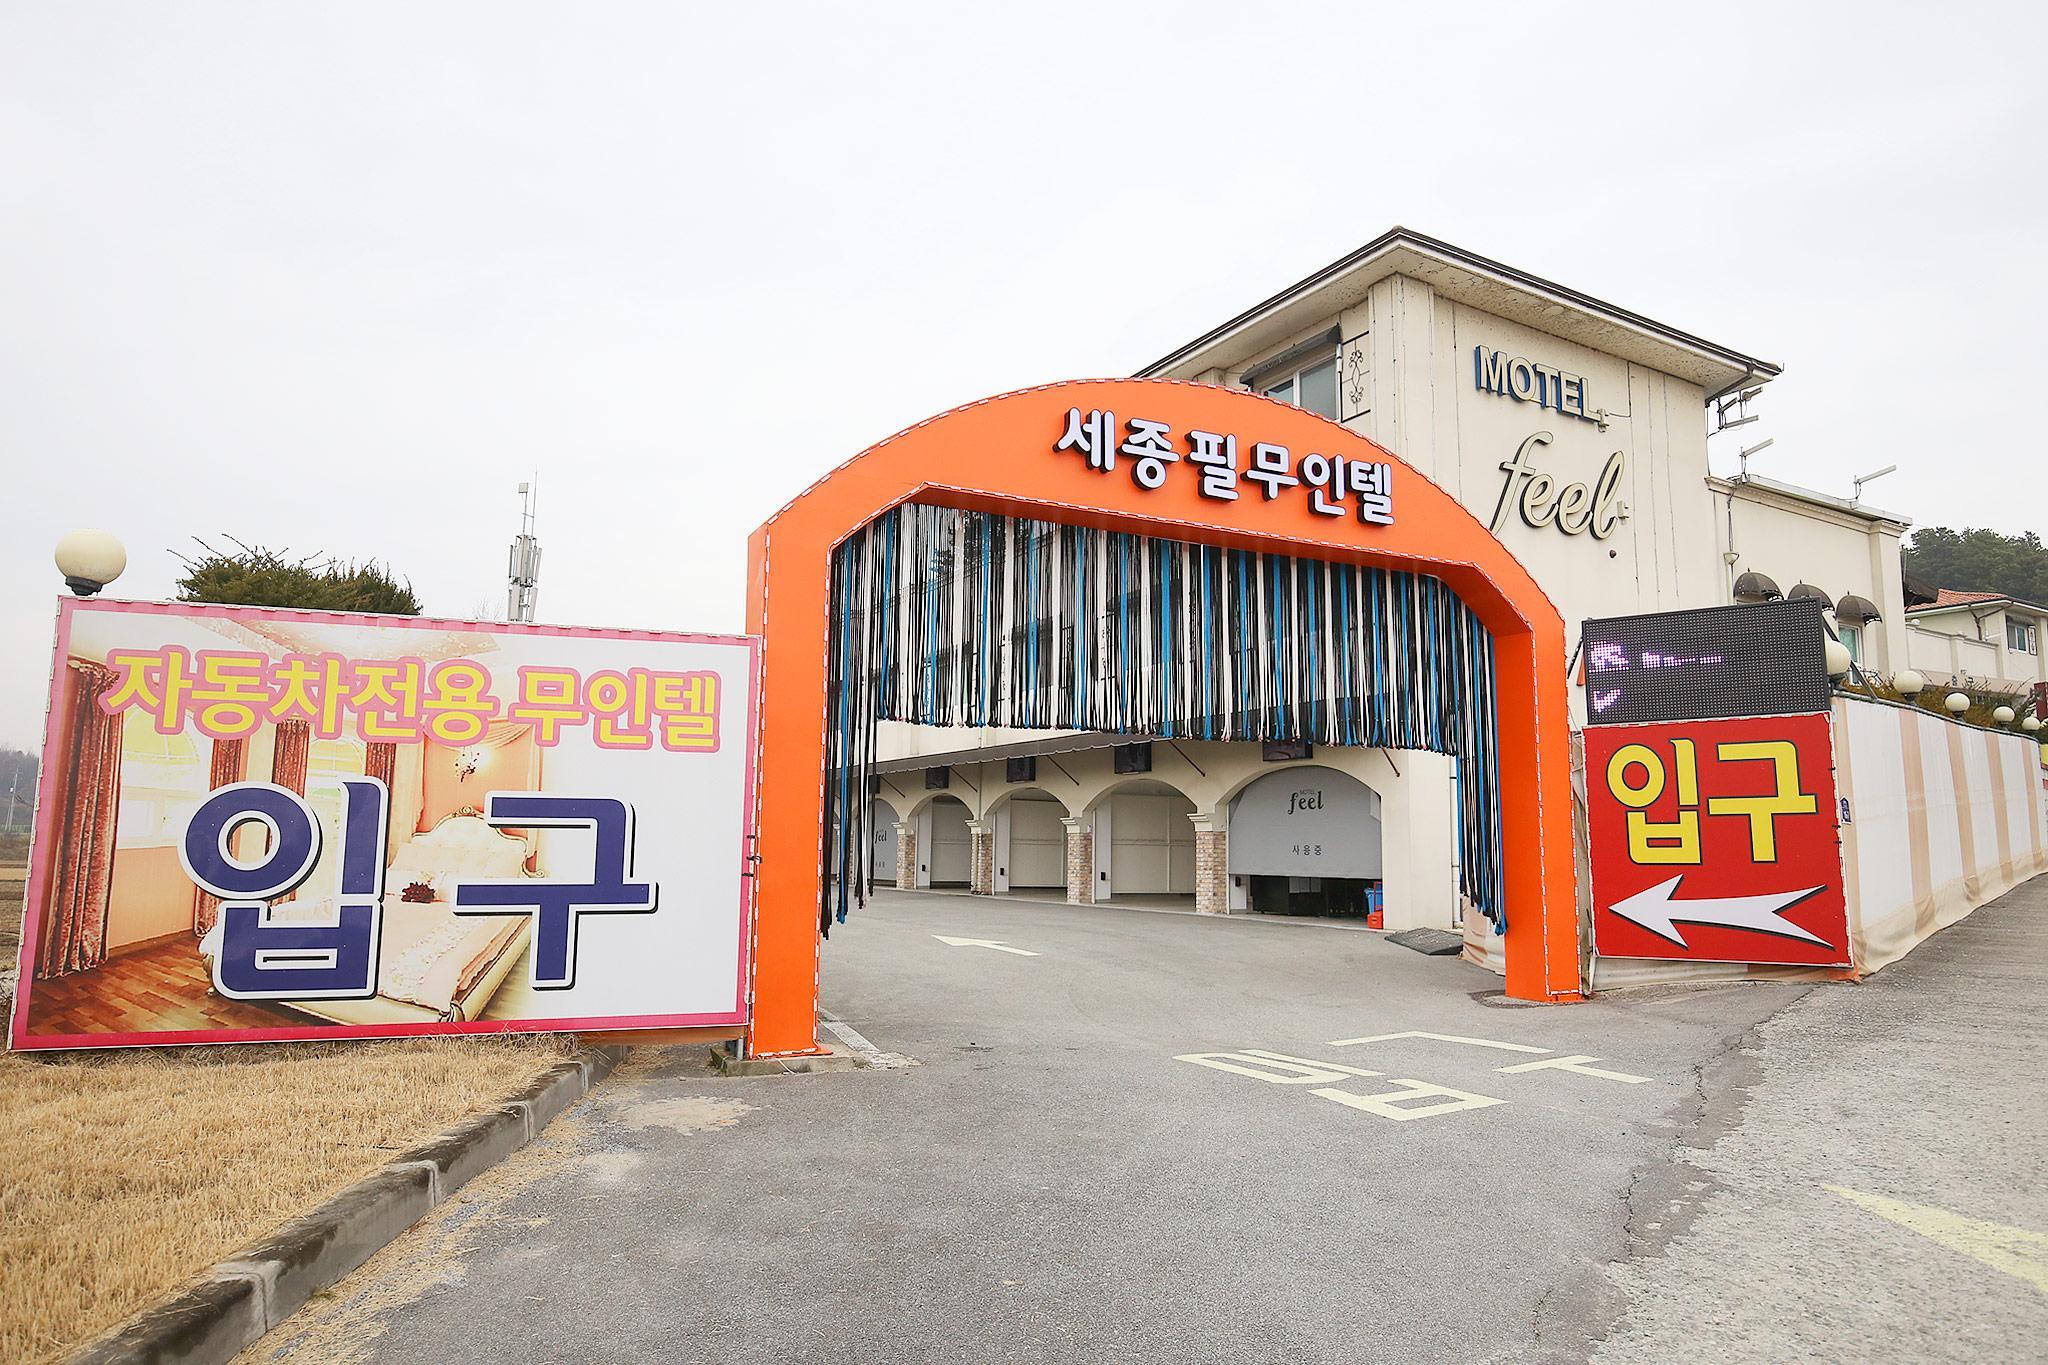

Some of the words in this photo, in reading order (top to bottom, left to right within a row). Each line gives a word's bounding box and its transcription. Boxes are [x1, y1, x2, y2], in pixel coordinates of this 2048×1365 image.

[1475, 345, 1601, 424] MOTEL
[1490, 431, 1624, 539] feel
[104, 648, 498, 745] 자동차전용
[510, 667, 720, 750] 무인텔
[1287, 790, 1324, 815] feel
[1606, 738, 1817, 865] 입구
[179, 776, 658, 1000] 입구
